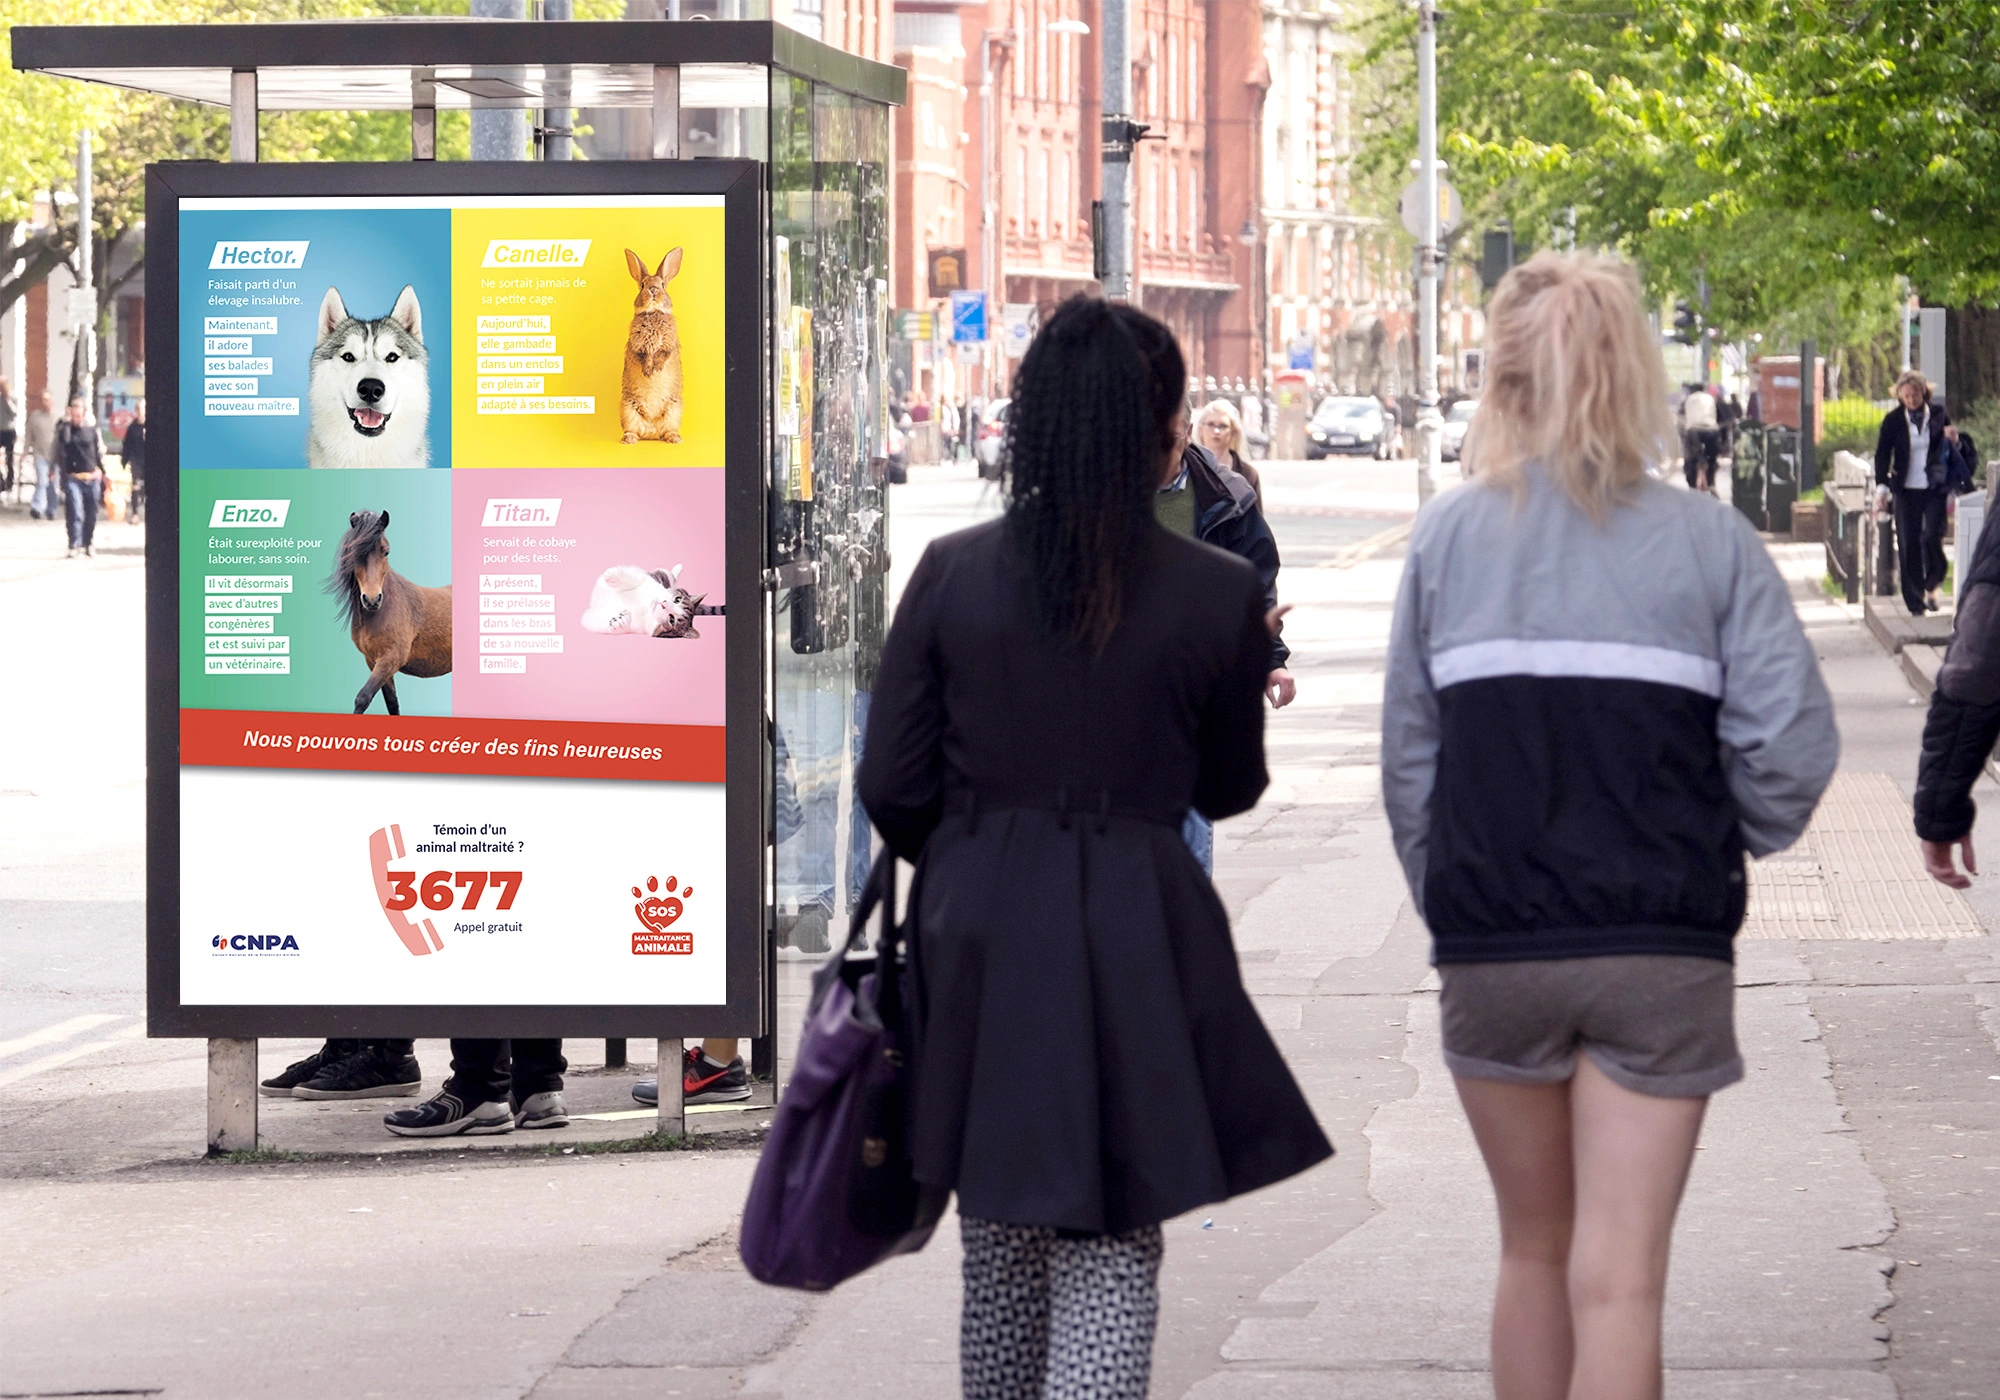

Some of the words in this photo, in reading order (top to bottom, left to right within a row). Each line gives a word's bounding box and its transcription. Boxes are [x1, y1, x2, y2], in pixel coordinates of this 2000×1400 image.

[221, 246, 296, 265] Hector.
[493, 243, 579, 263] Canelle.
[208, 279, 243, 290] Faisait
[244, 278, 270, 292] parti
[480, 278, 497, 289] Ne
[498, 277, 533, 289] sortait
[535, 277, 571, 291] jamais
[572, 277, 587, 288] de
[208, 294, 250, 308] élevage
[251, 294, 304, 306] insalubre.
[480, 295, 493, 305] sa
[495, 293, 527, 306] petite
[528, 295, 557, 307] cage.
[208, 319, 274, 330] Maintenant,
[208, 339, 215, 351] il
[217, 339, 249, 351] adore
[480, 337, 501, 349] elle
[502, 337, 553, 351] gambade
[208, 362, 226, 371] ses
[227, 359, 269, 371] balades
[480, 358, 507, 370] dans
[508, 361, 523, 369] un
[525, 358, 560, 369] enclos
[208, 382, 233, 391] avec
[235, 382, 254, 391] son
[480, 381, 495, 390] en
[497, 378, 524, 392] plein
[525, 378, 541, 389] air
[208, 402, 255, 412] nouveau
[257, 400, 295, 411] maître.
[480, 398, 518, 412] adapté
[519, 398, 527, 410] à
[528, 401, 547, 410] ses
[547, 398, 591, 410] besoins.
[221, 504, 278, 523] Enzo.
[493, 503, 551, 522] Titan.
[208, 535, 233, 549] Était
[235, 537, 295, 551] surexploité
[296, 539, 323, 551] pour
[483, 536, 521, 548] Servait
[521, 536, 537, 548] de
[538, 536, 577, 550] cobaye
[208, 553, 256, 565] labourer,
[258, 555, 283, 564] sans
[284, 552, 311, 564] soin.
[483, 554, 509, 565] pour
[510, 552, 531, 563] des
[532, 552, 562, 563] tests.
[208, 578, 216, 589] Il
[217, 577, 232, 589] vit
[233, 577, 289, 589] désormais
[482, 575, 492, 588] À
[493, 577, 538, 590] présent,
[208, 600, 233, 609] avec
[483, 597, 490, 608] il
[492, 599, 505, 608] se
[506, 597, 551, 610] prélasse
[208, 618, 271, 632] congénères
[483, 617, 509, 629] dans
[511, 617, 527, 628] les
[529, 617, 552, 628] bras
[208, 639, 220, 650] et
[222, 639, 239, 650] est
[241, 638, 266, 650] suivi
[267, 640, 287, 651] par
[483, 637, 497, 649] de
[499, 640, 512, 649] sa
[514, 638, 560, 649] nouvelle
[208, 661, 223, 670] un
[225, 658, 286, 670] vétérinaire.
[483, 657, 522, 669] famille.
[243, 730, 293, 748] Nous
[296, 735, 379, 753] pouvons
[383, 735, 425, 753] tous
[429, 736, 481, 755] créer
[484, 737, 520, 756] des
[523, 738, 559, 757] fins
[563, 740, 663, 761] heureuses
[432, 823, 477, 836] Témoin
[415, 840, 457, 853] animal
[459, 840, 515, 853] maltraité
[517, 840, 525, 853] ?
[386, 871, 522, 911] 3677
[647, 905, 678, 918] SOS
[453, 921, 485, 934] Appel
[487, 921, 523, 935] gratuit
[230, 934, 300, 951] CNPA
[633, 934, 691, 942] MALTRAITANCE
[633, 942, 691, 953] ANIMALE
